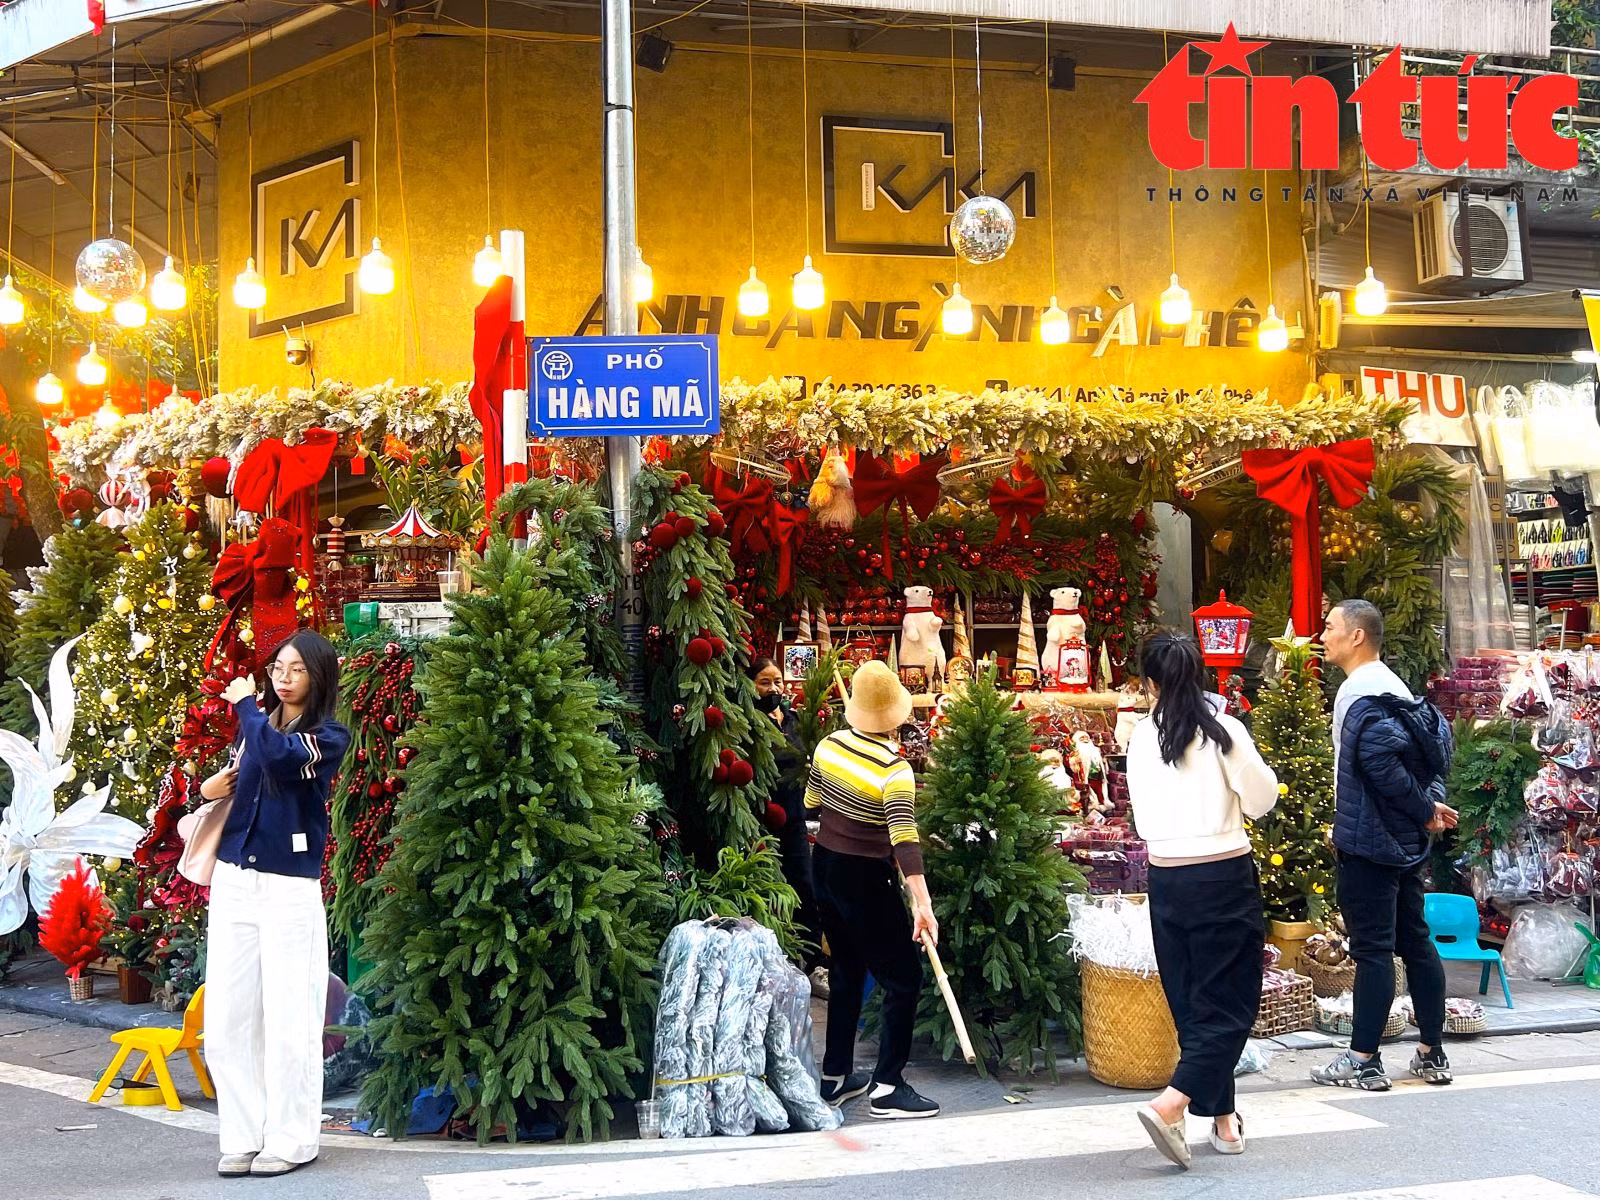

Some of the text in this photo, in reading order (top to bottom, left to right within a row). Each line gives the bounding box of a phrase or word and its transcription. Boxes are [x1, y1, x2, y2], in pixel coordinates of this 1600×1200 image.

[607, 346, 665, 370] PHỐ
[548, 378, 705, 419] HÀNG MÃ
[1363, 368, 1466, 419] THU
